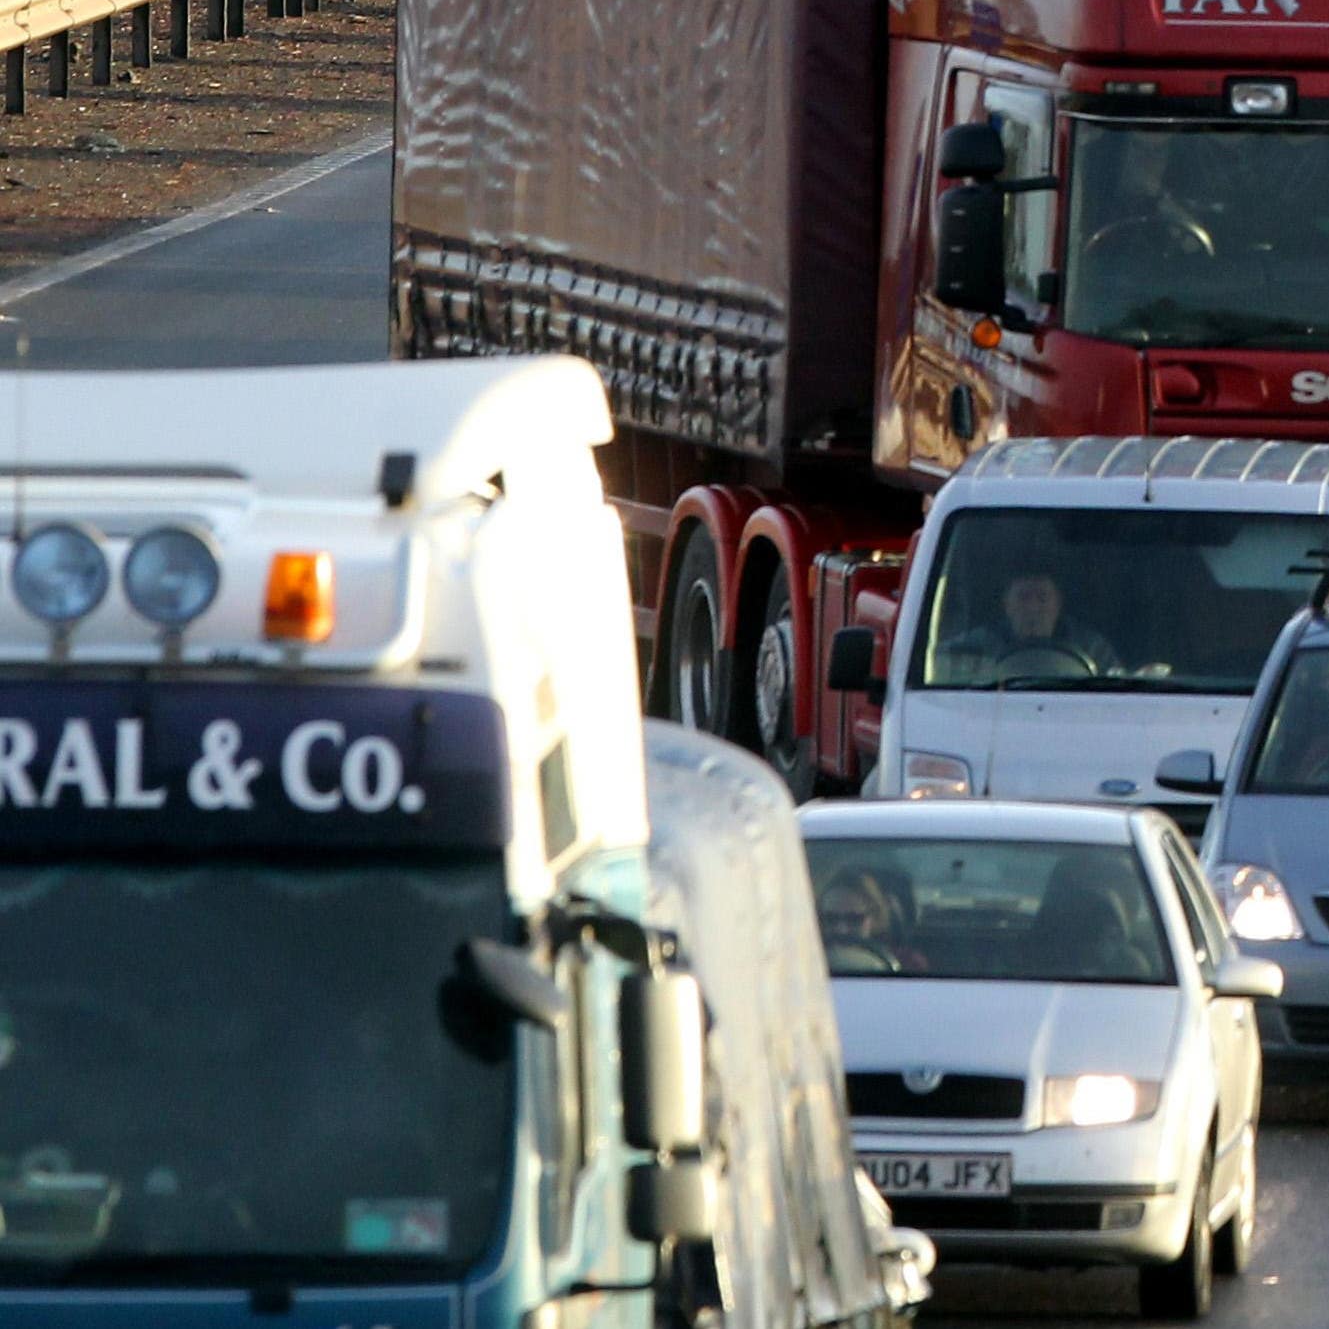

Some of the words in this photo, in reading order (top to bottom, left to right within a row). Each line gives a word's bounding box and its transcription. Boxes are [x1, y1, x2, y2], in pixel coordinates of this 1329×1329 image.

[187, 718, 263, 810] &
[281, 719, 426, 814] Co.
[944, 1161, 1001, 1189] JFX
